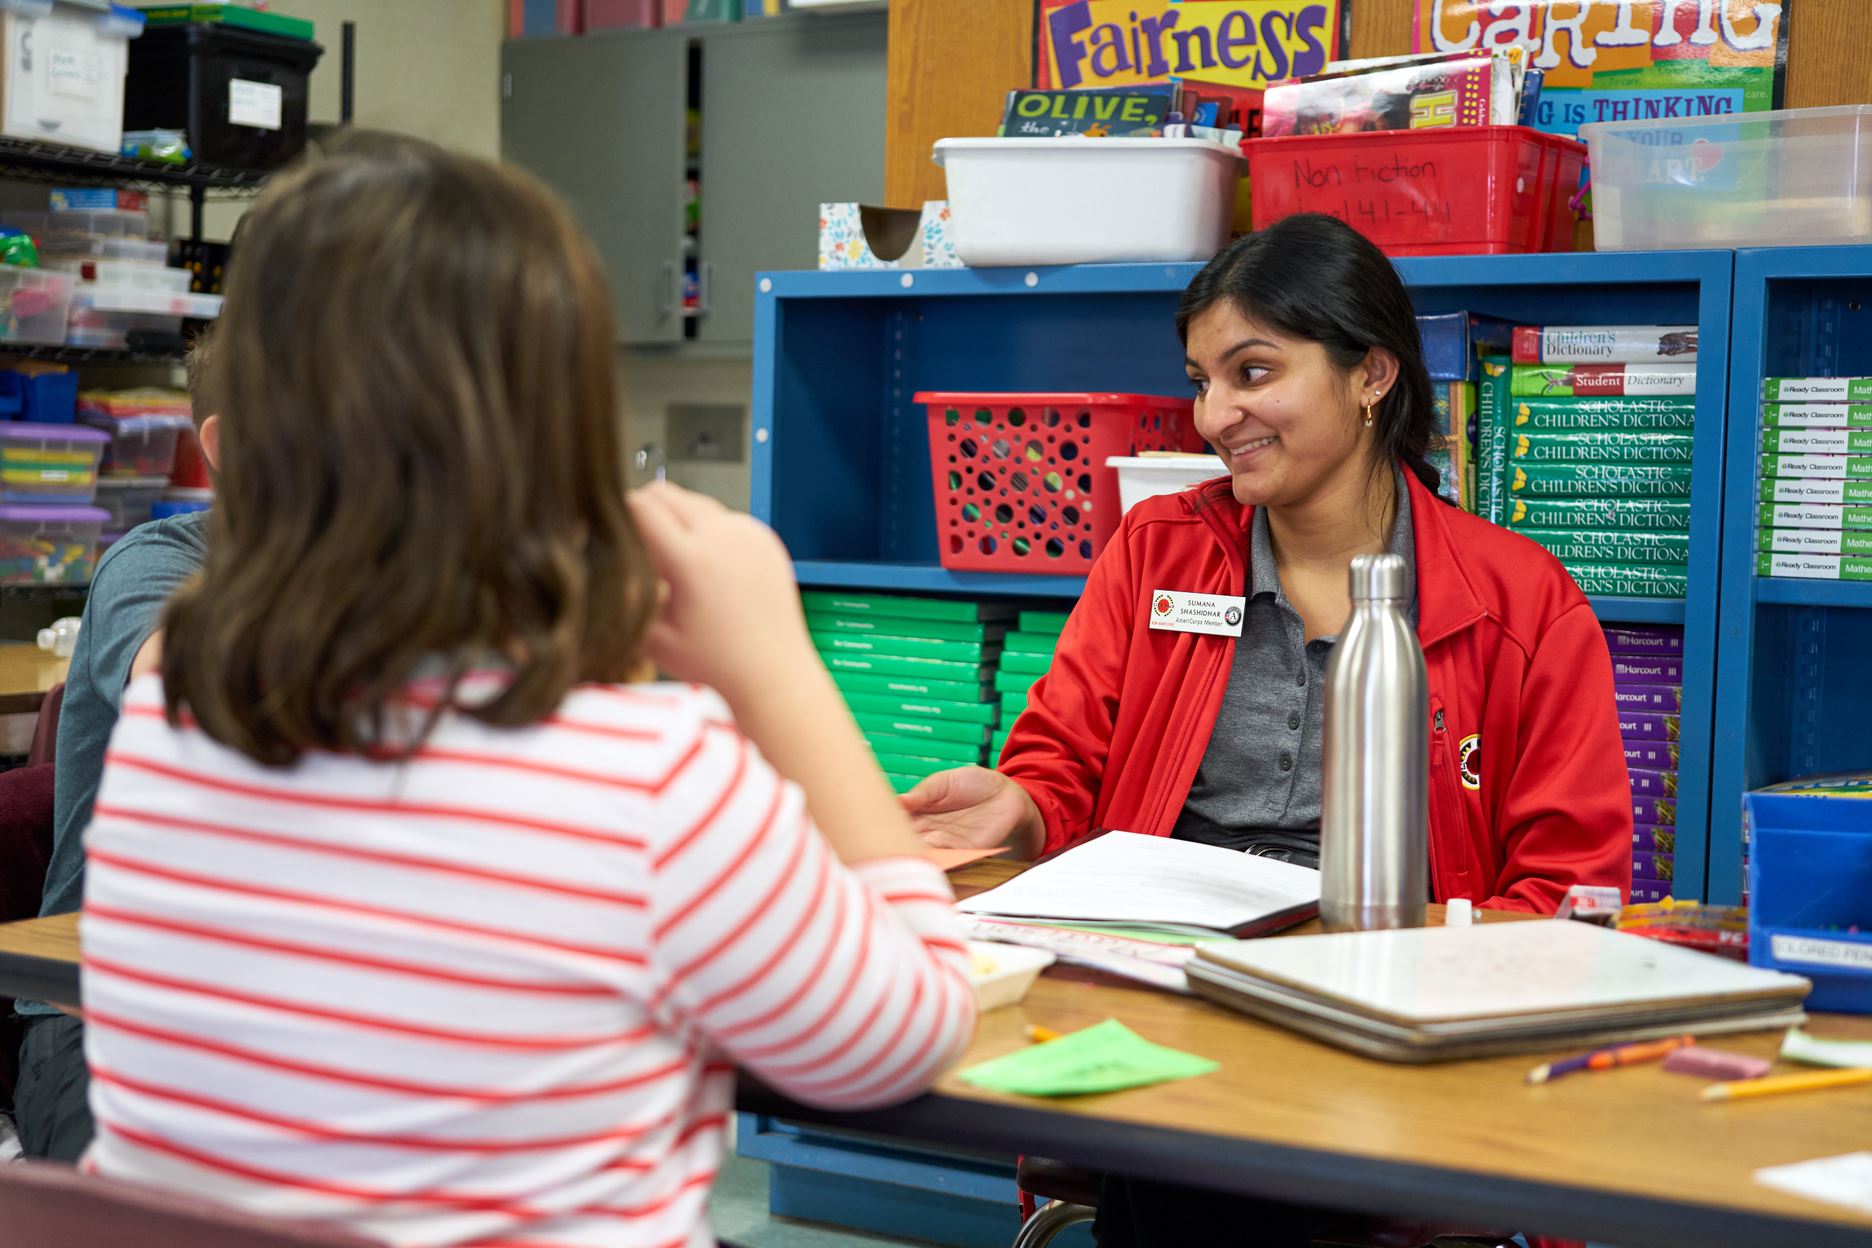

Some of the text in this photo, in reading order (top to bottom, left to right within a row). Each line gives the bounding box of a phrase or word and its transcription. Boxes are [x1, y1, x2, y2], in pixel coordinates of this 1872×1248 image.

[1048, 0, 1327, 88] Fairness
[1017, 94, 1158, 125] OLIVE,
[1564, 103, 1585, 124] IS
[1593, 95, 1733, 122] THINKING
[1019, 121, 1049, 135] the
[1294, 157, 1341, 189] Non
[1546, 331, 1616, 345] Children's
[1546, 343, 1614, 357] Dictionary
[1576, 373, 1621, 387] Student
[1628, 374, 1685, 387] Dictionary
[1789, 386, 1809, 394] Ready
[1578, 400, 1673, 413] SCHOLASTIC
[1534, 414, 1619, 427] CHILDREN'S
[1789, 411, 1809, 419] Ready
[1480, 381, 1493, 469] CHILDREN'S
[1577, 433, 1674, 446] SCHOLASTIC
[1789, 438, 1809, 446] Ready
[1534, 446, 1620, 459] CHILDREN'S
[1575, 467, 1672, 479] SCHOLASTIC
[1786, 463, 1807, 471] Ready
[1809, 463, 1843, 471] Classroom
[1492, 426, 1506, 522] SCHOLASTIC
[1531, 480, 1618, 493] CHILDREN'S
[1784, 487, 1804, 495] Ready
[1574, 499, 1669, 512] SCHOLASTIC
[1530, 512, 1616, 525] CHILDREN'S
[1783, 512, 1803, 520] Ready
[1805, 512, 1839, 520] Classroom
[1572, 532, 1666, 546] SCHOLASTIC
[1782, 536, 1802, 544] Ready
[1541, 543, 1614, 558] HILDREN'S
[1571, 565, 1667, 580] SCHOLASTIC
[1781, 562, 1801, 570] Ready
[1803, 562, 1837, 570] Classroom
[1187, 599, 1216, 608] SUMANA
[1180, 608, 1221, 617] SHASHIDHAR
[1175, 617, 1203, 625] AmeriCorps
[1203, 619, 1223, 627] Member
[1627, 636, 1663, 646] Harcourt
[1625, 665, 1661, 675] Harcourt
